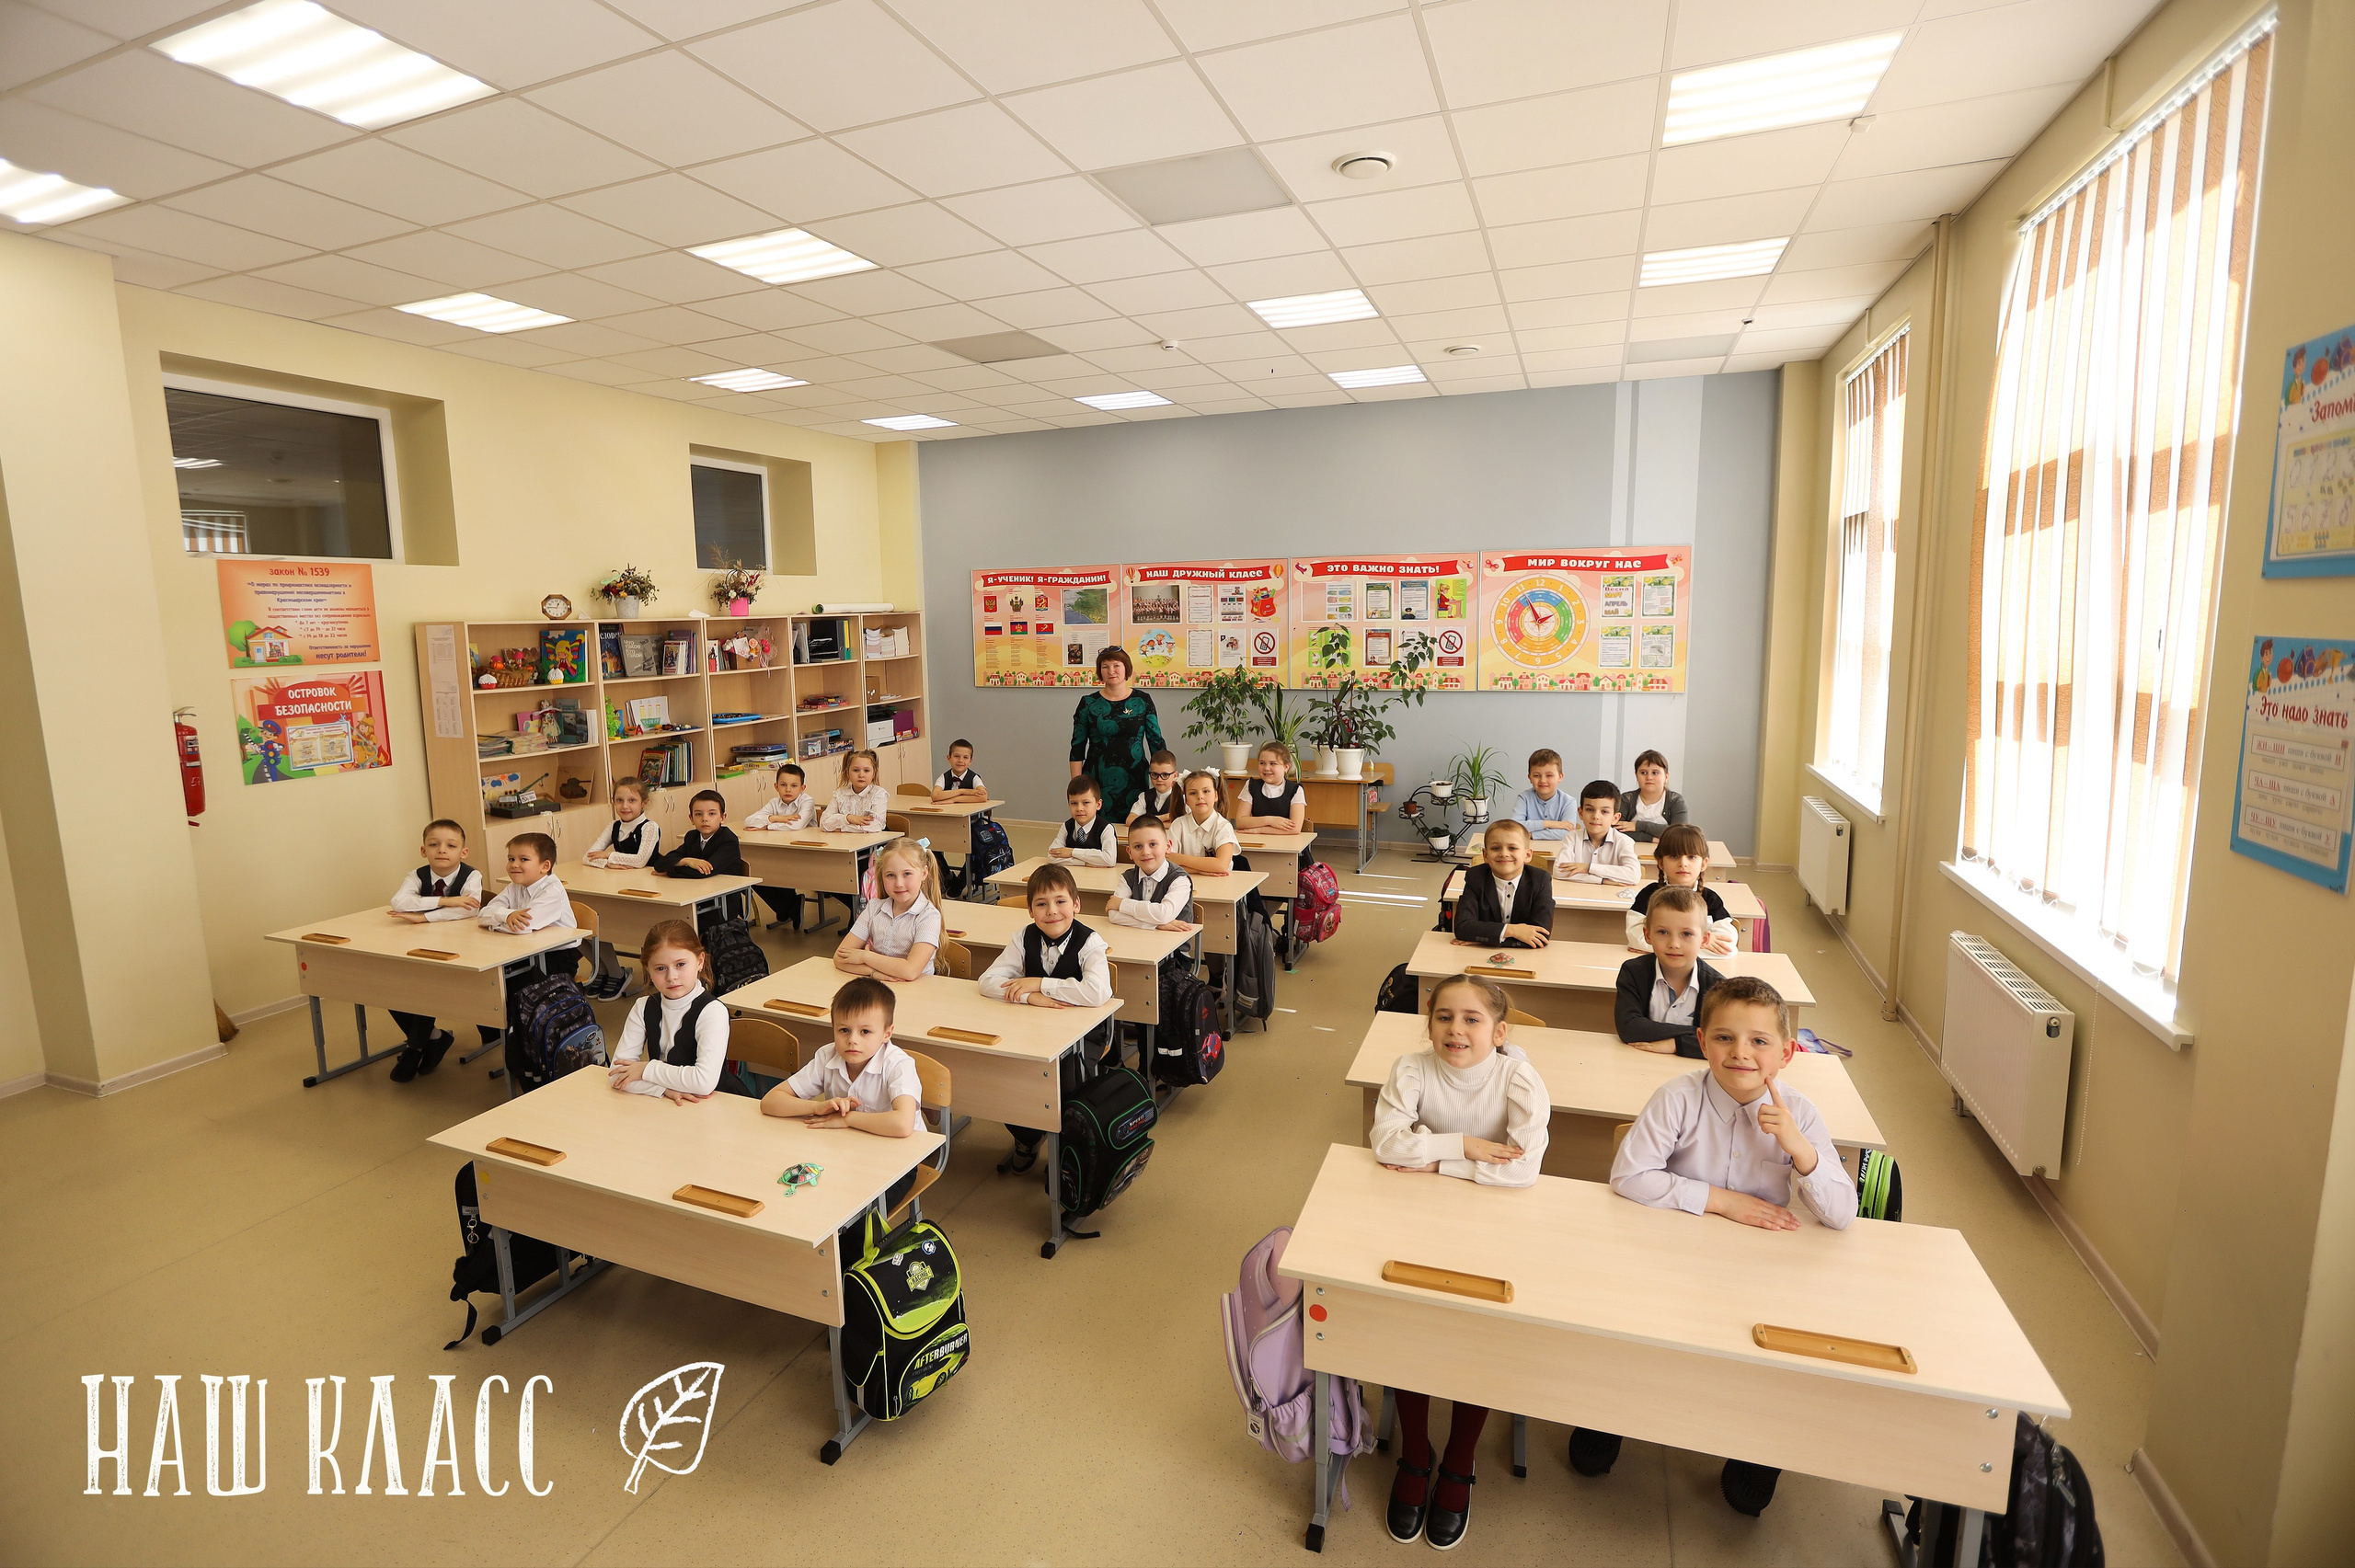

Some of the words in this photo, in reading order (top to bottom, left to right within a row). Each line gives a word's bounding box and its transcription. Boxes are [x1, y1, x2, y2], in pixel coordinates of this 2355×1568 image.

[2312, 397, 2355, 423] Запом
[1327, 564, 1349, 572] ЭТО
[1352, 564, 1395, 573] ВАЖНО
[1398, 565, 1440, 574] ЗНАТЬ!
[1527, 558, 1556, 567] МИР
[1560, 559, 1610, 568] ВОКРУГ
[1614, 560, 1642, 568] НАС
[310, 567, 330, 577] 1539
[1145, 569, 1169, 578] НАШ
[1172, 568, 1225, 578] ДРУЖНЫЙ
[1229, 569, 1263, 578] КЛАСС
[987, 575, 1034, 584] Я-УЧЕНИК!
[1037, 574, 1107, 585] Я-ГРАЖДАНИН!
[1535, 578, 1545, 587] 12
[316, 652, 334, 660] несут
[336, 650, 367, 660] родители!
[288, 687, 337, 699] ОСТРОВОК
[275, 700, 352, 716] БЕЗОПАСНОСТИ
[2260, 695, 2279, 716] Это
[2282, 704, 2308, 722] надо
[2313, 705, 2349, 728] знать
[2310, 750, 2332, 762] буквой
[2304, 788, 2326, 802] буквой
[2301, 827, 2322, 841] буквой
[1129, 1114, 1144, 1127] SPEED
[913, 1333, 968, 1370] AFTERBURNER
